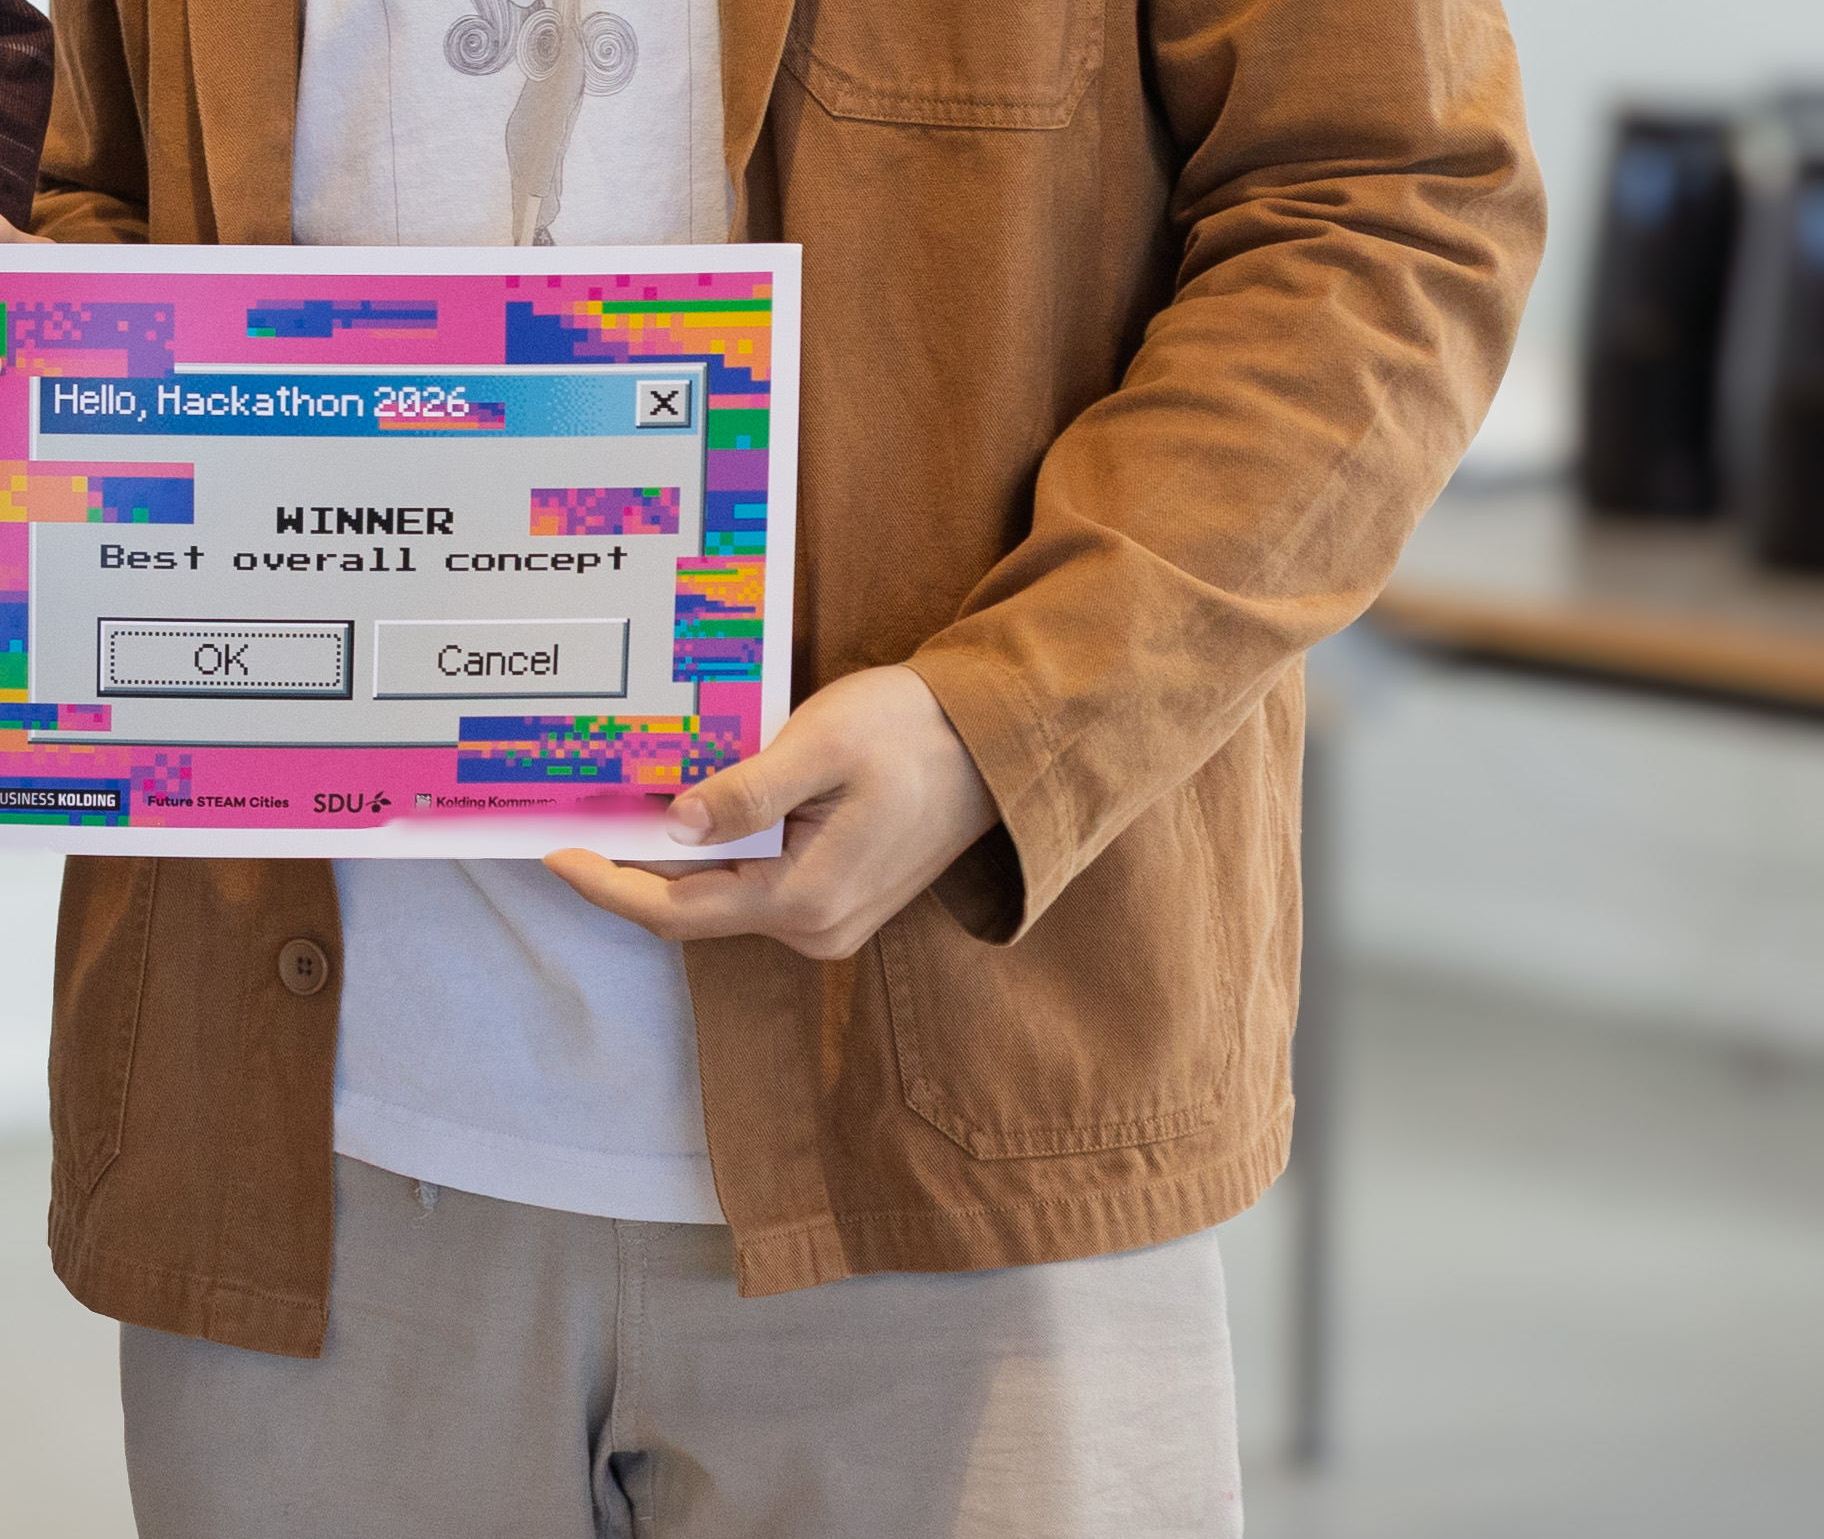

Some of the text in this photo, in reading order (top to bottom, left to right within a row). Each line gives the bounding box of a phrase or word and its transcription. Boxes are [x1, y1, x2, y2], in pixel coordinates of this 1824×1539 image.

[53, 383, 470, 423] Hello, Hackathon 2026
[276, 506, 454, 535] WINNER
[100, 544, 629, 574] Best overall concept
[194, 643, 249, 676] OK
[437, 643, 560, 677] Cancel
[57, 792, 116, 807] KOLDING
[147, 795, 290, 809] Future STEAM Cities
[313, 793, 364, 814] SDU
[436, 796, 486, 810] Kolding
